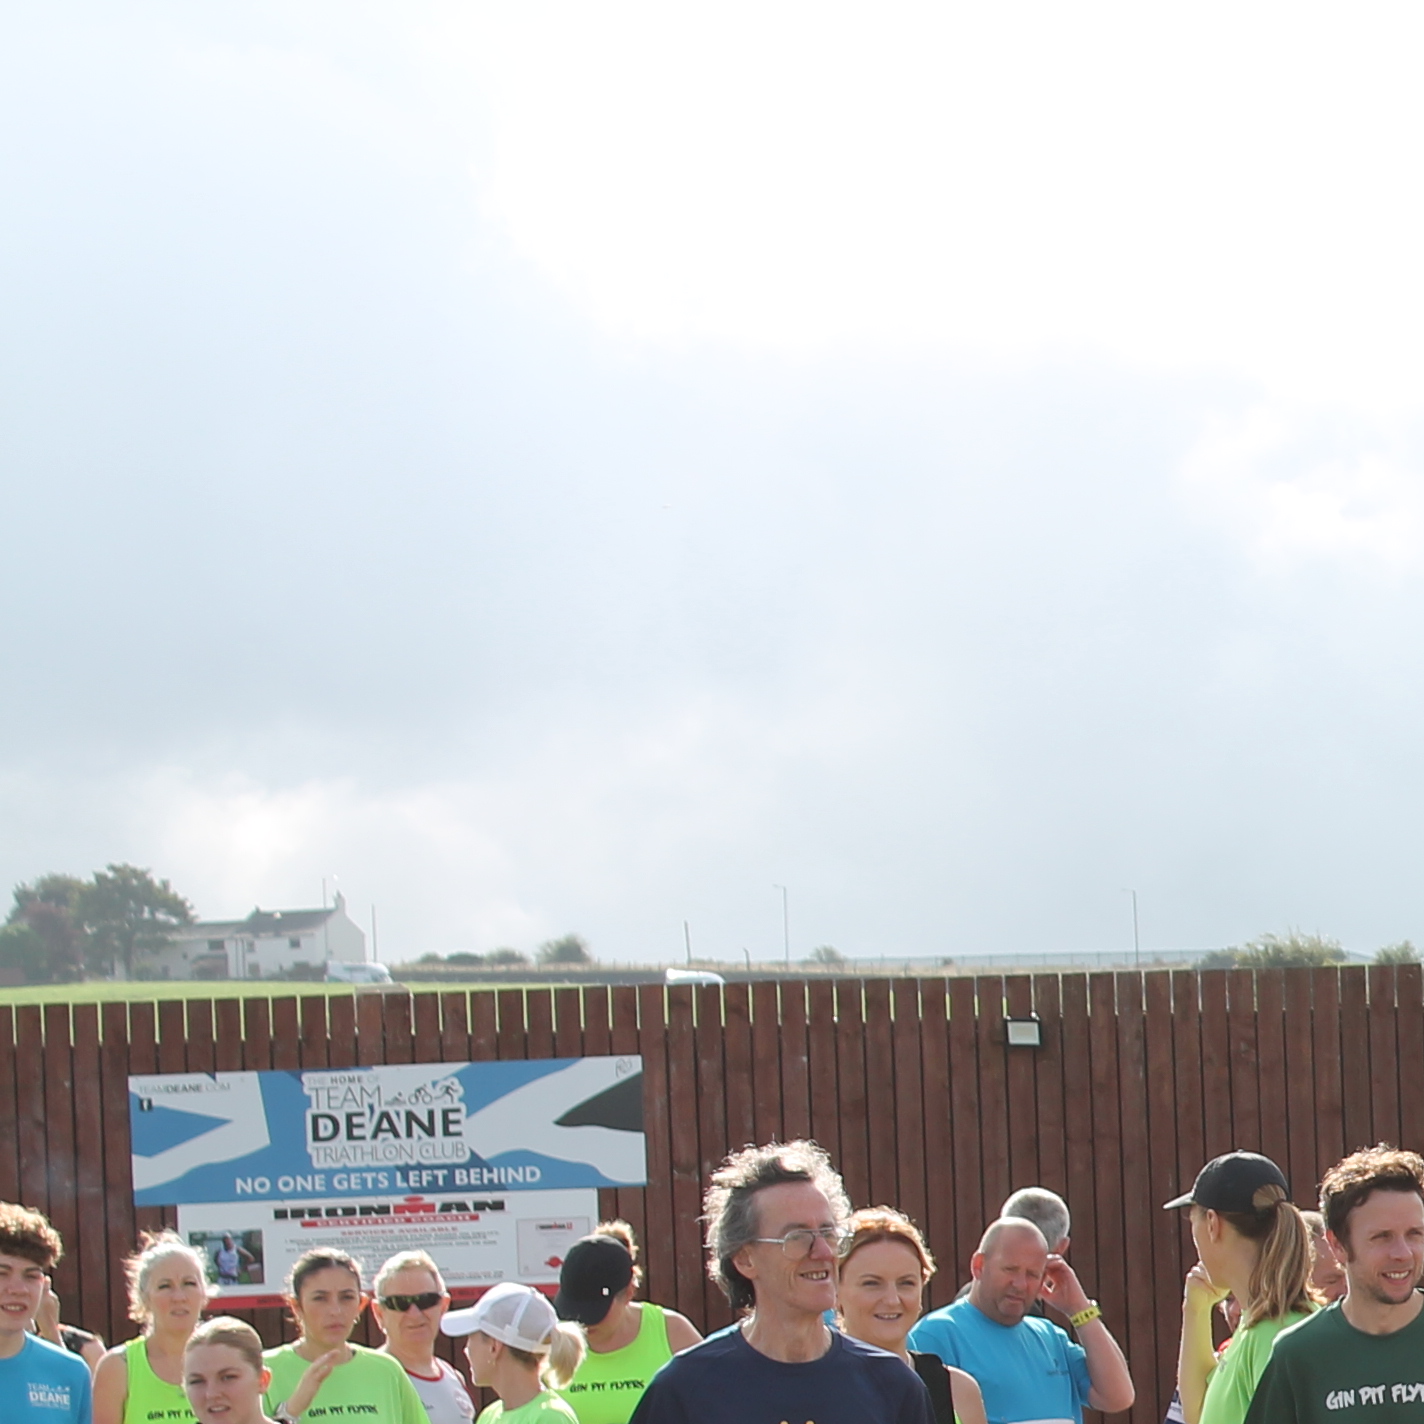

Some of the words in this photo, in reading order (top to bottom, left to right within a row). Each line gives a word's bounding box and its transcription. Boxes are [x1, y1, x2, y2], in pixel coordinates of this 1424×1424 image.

[330, 1075, 363, 1085] HOME
[308, 1085, 382, 1110] TEAM
[311, 1108, 463, 1143] DEANE
[313, 1142, 413, 1164] TRIATHLON
[419, 1141, 466, 1160] CLUB
[235, 1177, 270, 1195] NO
[277, 1174, 326, 1192] ONE
[333, 1171, 389, 1190] GETS
[396, 1169, 448, 1188] LEFT
[454, 1166, 542, 1186] BEHIND
[273, 1196, 505, 1220] IRONMAN
[1326, 1389, 1355, 1410] GIN
[1359, 1385, 1386, 1405] PIT
